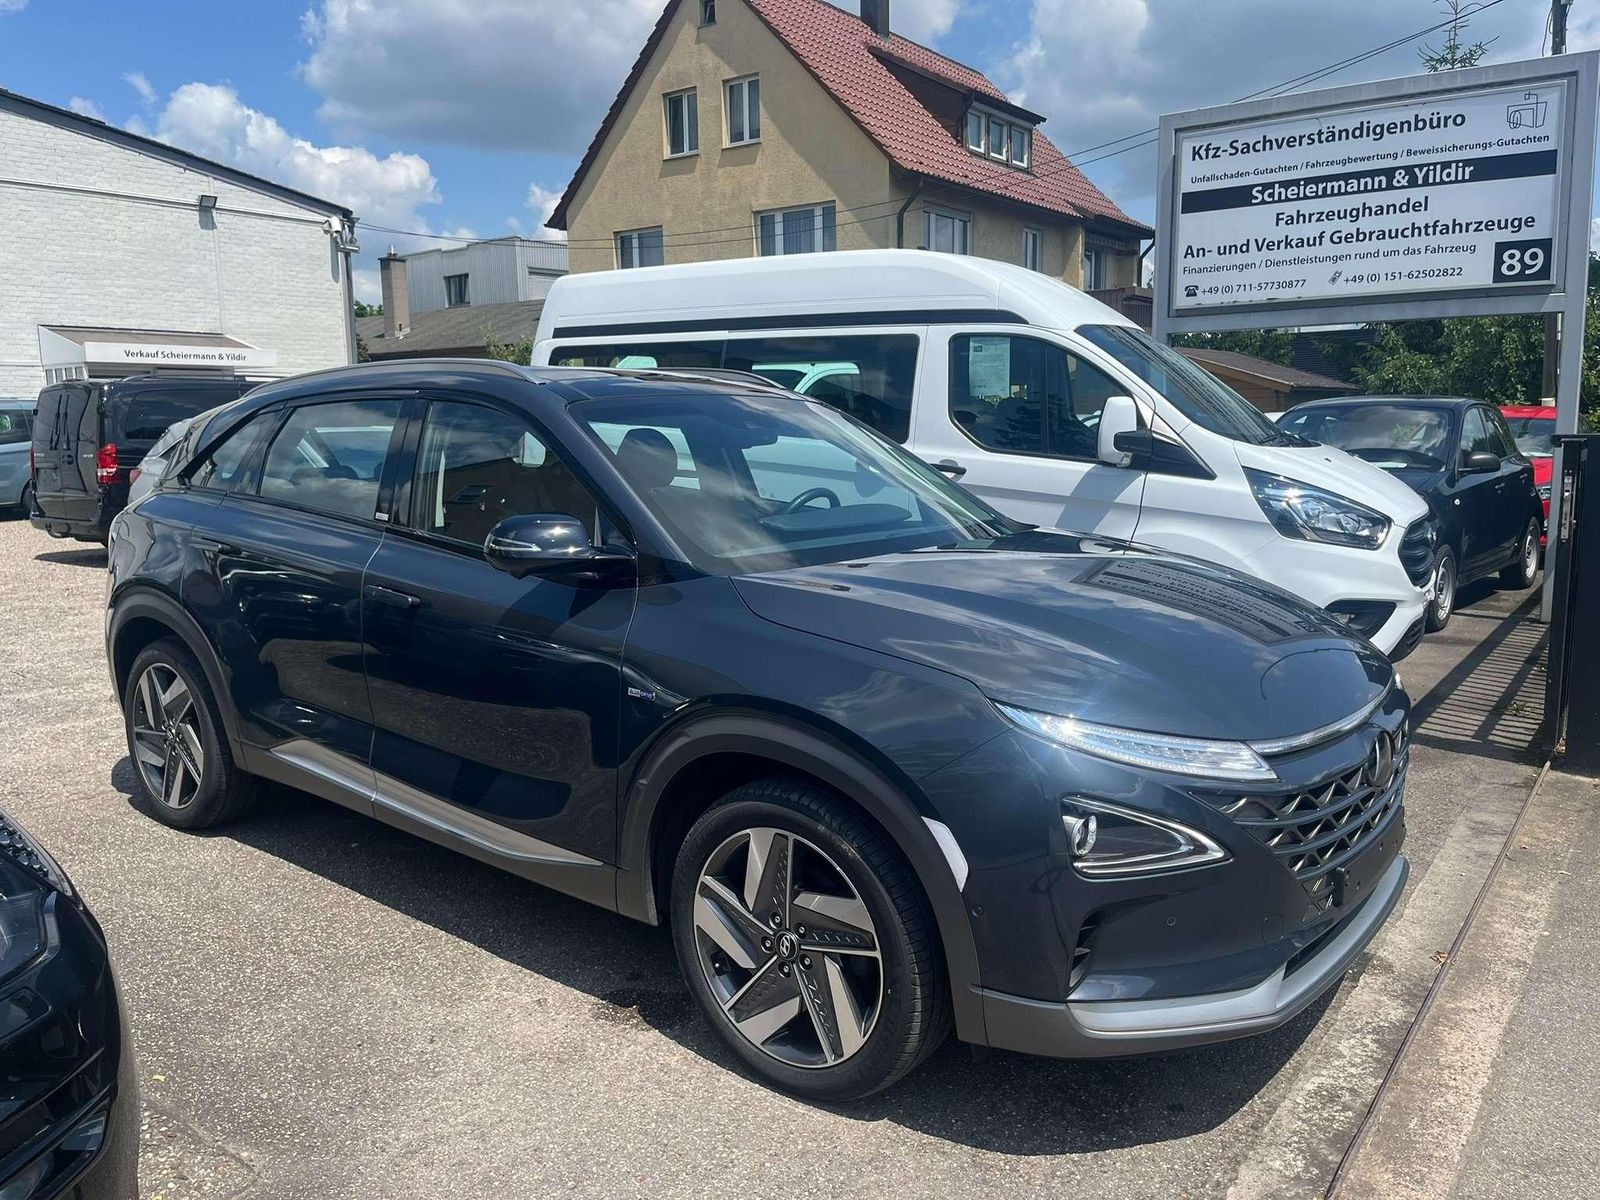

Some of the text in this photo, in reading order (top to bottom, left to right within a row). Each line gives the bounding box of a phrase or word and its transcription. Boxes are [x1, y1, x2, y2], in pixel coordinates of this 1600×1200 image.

[1191, 112, 1466, 161] Kfz-Sachverständigenbüro
[1191, 163, 1298, 184] Unfallschaden-Gutachten
[1305, 150, 1399, 169] Fahrzeugbewertung
[1406, 135, 1550, 157] Beweissicherungs-Gutachten
[1251, 162, 1474, 204] Scheiermann & Yildir
[1275, 196, 1429, 227] Fahrzeughandel
[1183, 215, 1536, 259] An- und Verkauf Gebrauchtfahrzeuge
[1183, 261, 1257, 275] Finanzierungen
[1264, 253, 1352, 268] Dienstleistungen
[1354, 249, 1379, 260] rund
[1382, 249, 1400, 258] um
[1402, 245, 1422, 256] das
[1424, 243, 1477, 255] Fahrzeug
[1500, 247, 1545, 276] 89
[1201, 279, 1307, 295] +49 (0) 711-57730877
[1344, 267, 1463, 284] +49 (0) 151-62502822
[124, 350, 247, 361] Verkauf Scheiermann & Yildir
